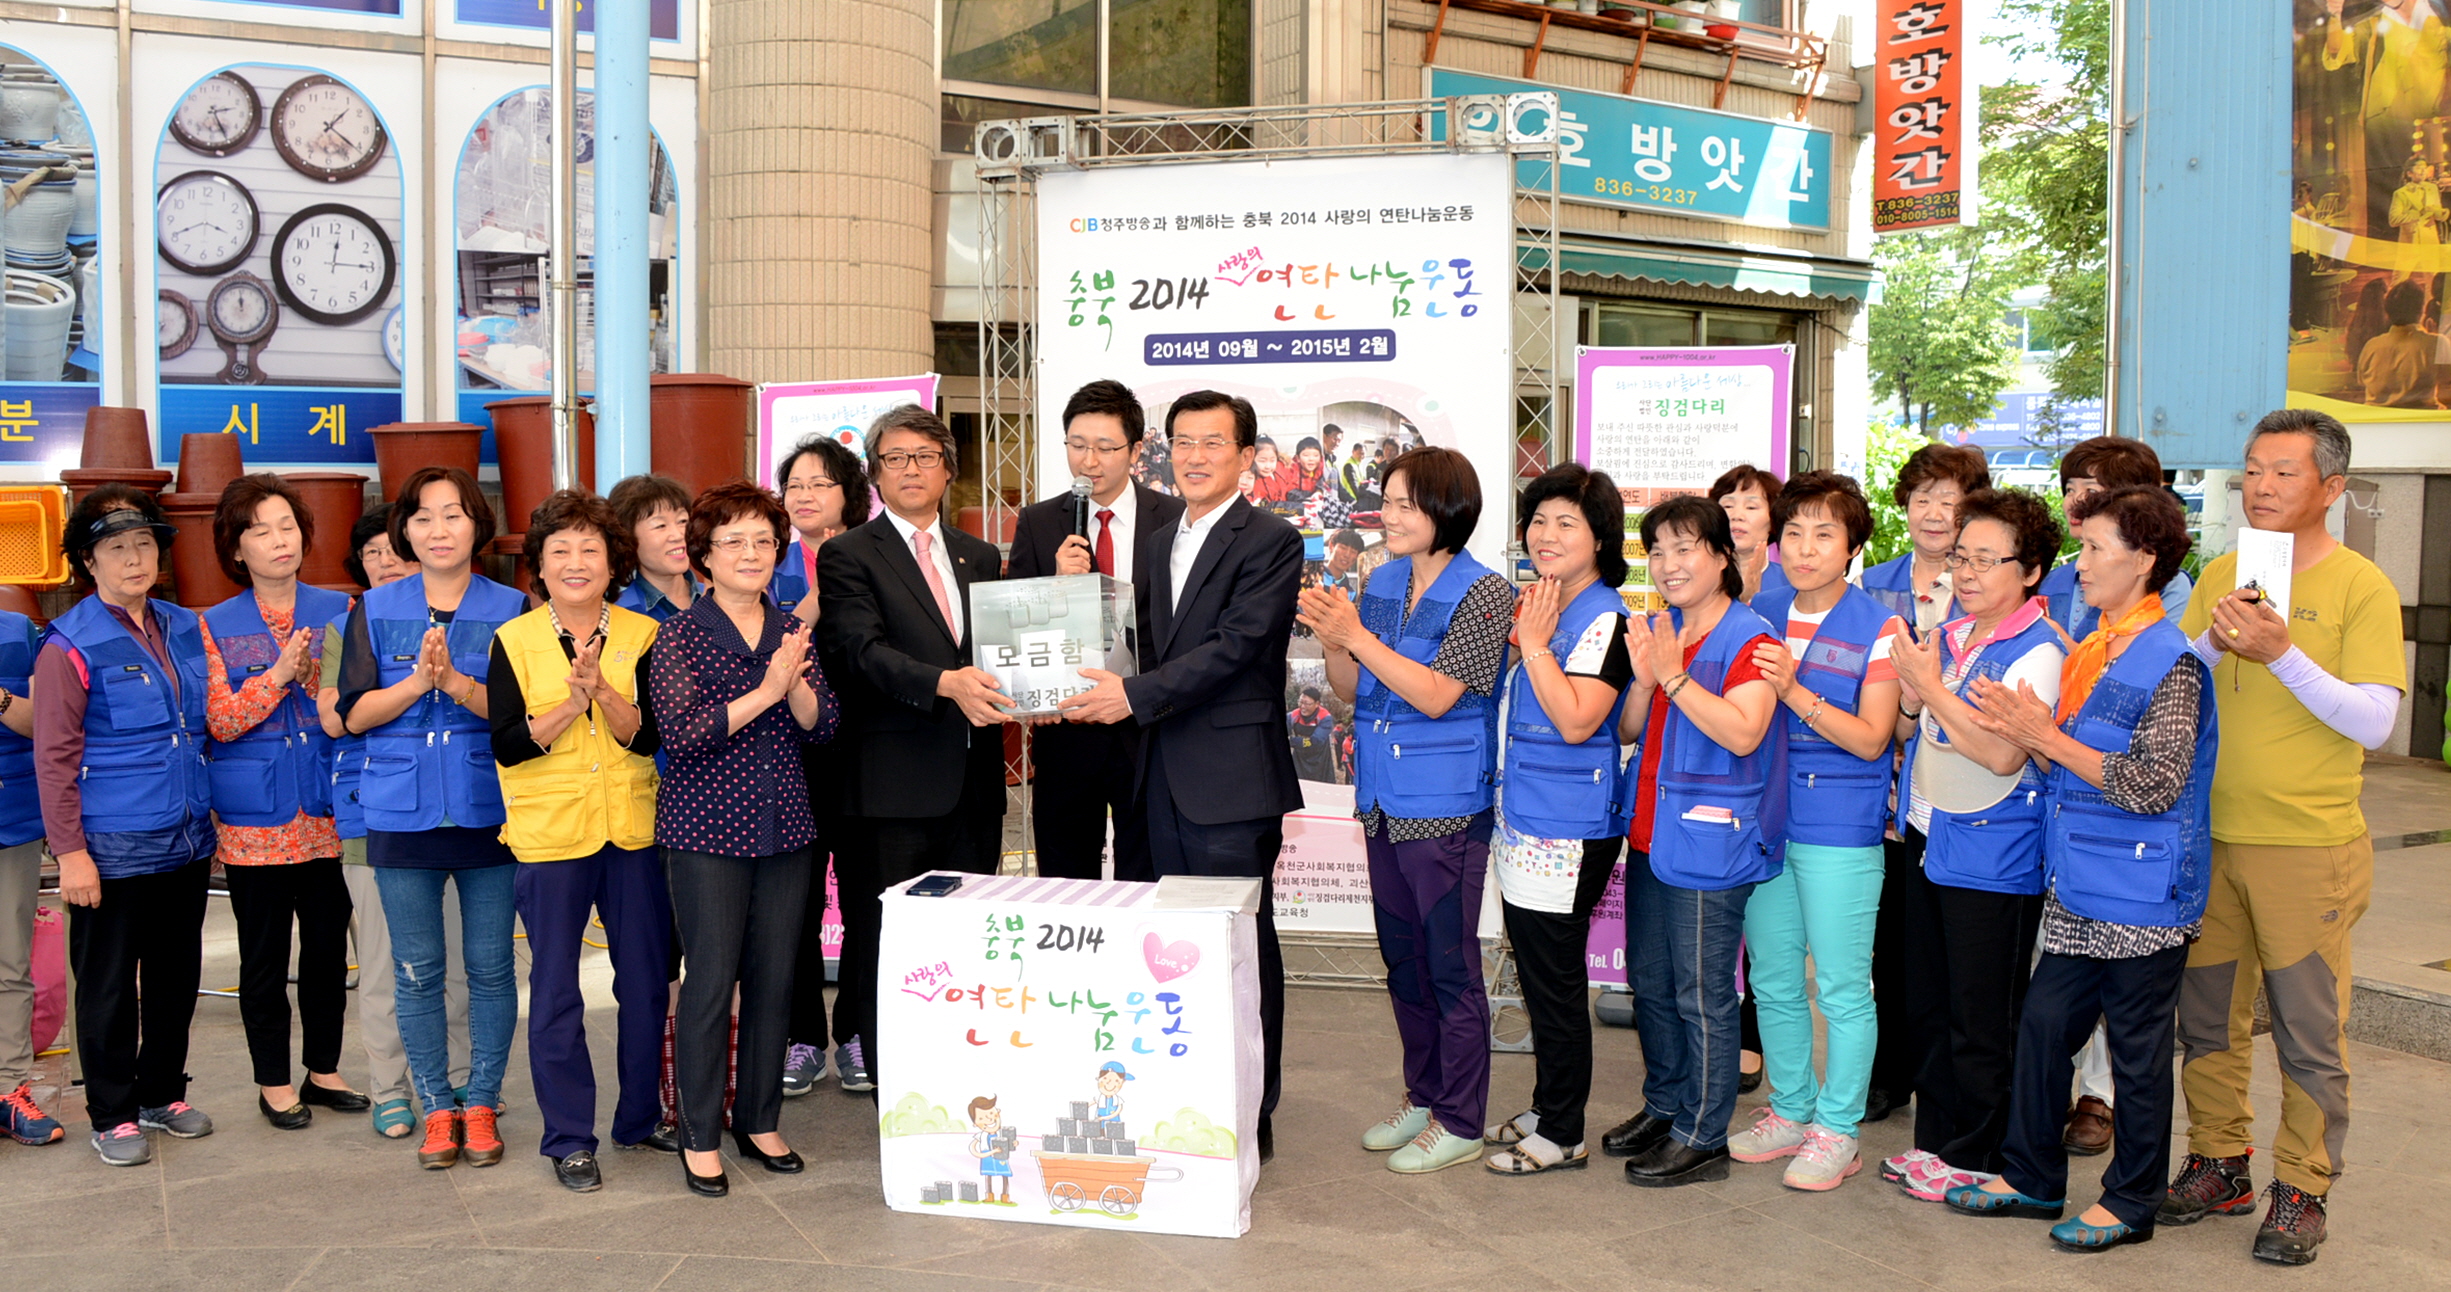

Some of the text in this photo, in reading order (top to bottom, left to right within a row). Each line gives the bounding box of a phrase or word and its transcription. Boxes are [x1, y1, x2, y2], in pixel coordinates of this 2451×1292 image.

[1594, 176, 1699, 206] 836-3237
[1877, 192, 1959, 211] T.836-3237
[1175, 213, 1235, 231] 함께하는
[1243, 211, 1273, 229] 충북
[1281, 211, 1317, 226] 2014
[1325, 208, 1371, 226] 사랑의
[1379, 205, 1475, 225] 연탄나눔운동
[1876, 206, 1959, 225] 010-8005-1514
[293, 223, 375, 307] 12 1 2 3 4 5 6 7 8 9 10 11
[1218, 246, 1264, 273] 사랑의
[1063, 269, 1116, 352] 충북
[1129, 277, 1209, 311] 2014
[1152, 340, 1209, 359] 2014년
[1219, 338, 1258, 358] 09월
[1291, 338, 1350, 356] 2015년
[1360, 336, 1389, 355] 2월
[1666, 373, 1712, 393] 아름다운
[1655, 398, 1725, 417] 징검다리
[1620, 490, 1640, 504] 연도
[1622, 595, 1645, 608] 009년
[996, 638, 1085, 668] 모금함
[1277, 861, 1369, 873] 옥천군사회복지협의
[981, 913, 1105, 982] 충북 2014
[1154, 954, 1178, 970] Love
[1589, 954, 1607, 968] Tel.
[905, 961, 953, 986] 사랑의
